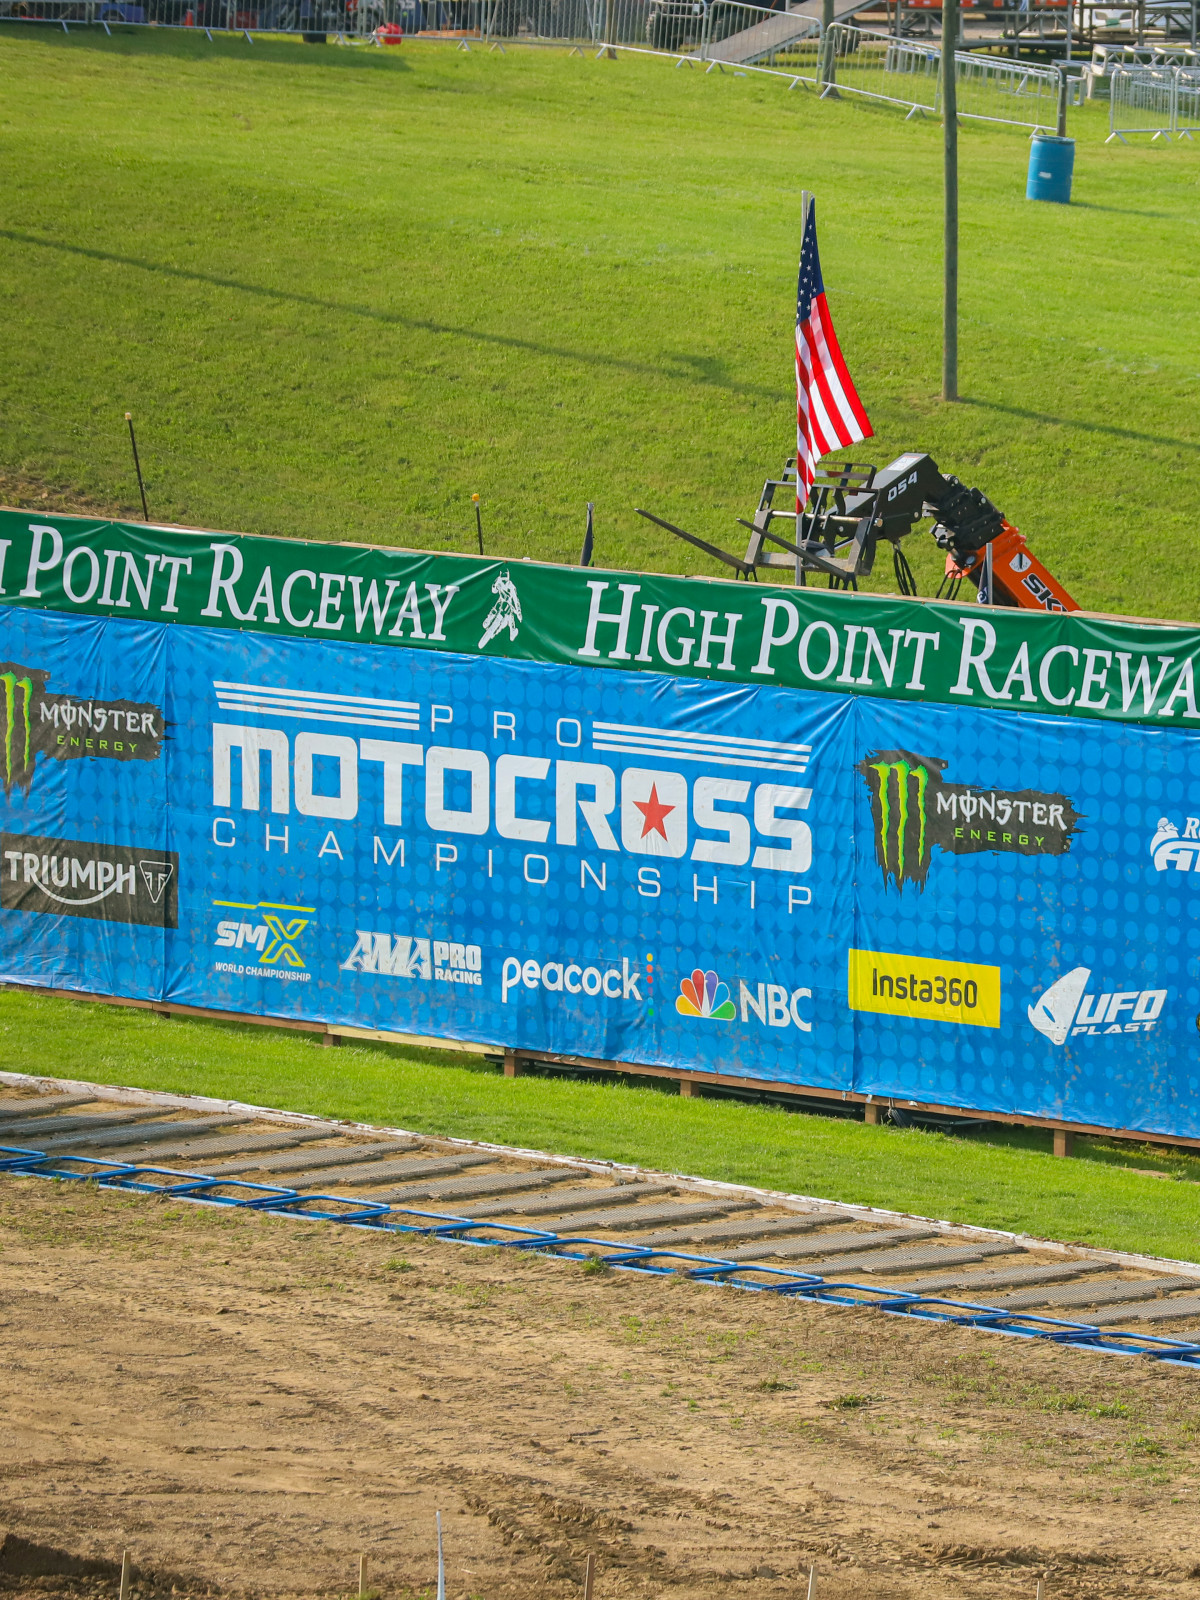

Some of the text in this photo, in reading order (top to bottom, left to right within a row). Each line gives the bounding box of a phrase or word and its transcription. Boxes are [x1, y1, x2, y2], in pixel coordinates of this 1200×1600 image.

[19, 524, 192, 613] POINT
[201, 543, 459, 641] RACEWAY
[577, 580, 743, 671] HIGH
[751, 597, 940, 691] POINT
[40, 700, 159, 738] MONSTER
[431, 704, 582, 749] PRO
[57, 735, 138, 753] ENERGY
[212, 722, 813, 874] MOTOCROSS
[936, 790, 1067, 831] MONSTER
[954, 827, 1045, 847] ENERGY
[4, 851, 136, 905] TRIUMPH
[213, 817, 812, 914] CHAMPIONSHIP
[214, 914, 309, 968] SMX
[339, 930, 432, 981] AMA
[433, 940, 482, 971] PRO
[215, 962, 311, 982] WORLD CHAMPIONSHIP
[434, 970, 482, 985] RACING
[502, 956, 643, 1003] peacock
[872, 967, 978, 1008] Insta360
[739, 979, 812, 1032] NBC
[1076, 989, 1168, 1025] UFO
[1071, 1021, 1156, 1037] PLAST
